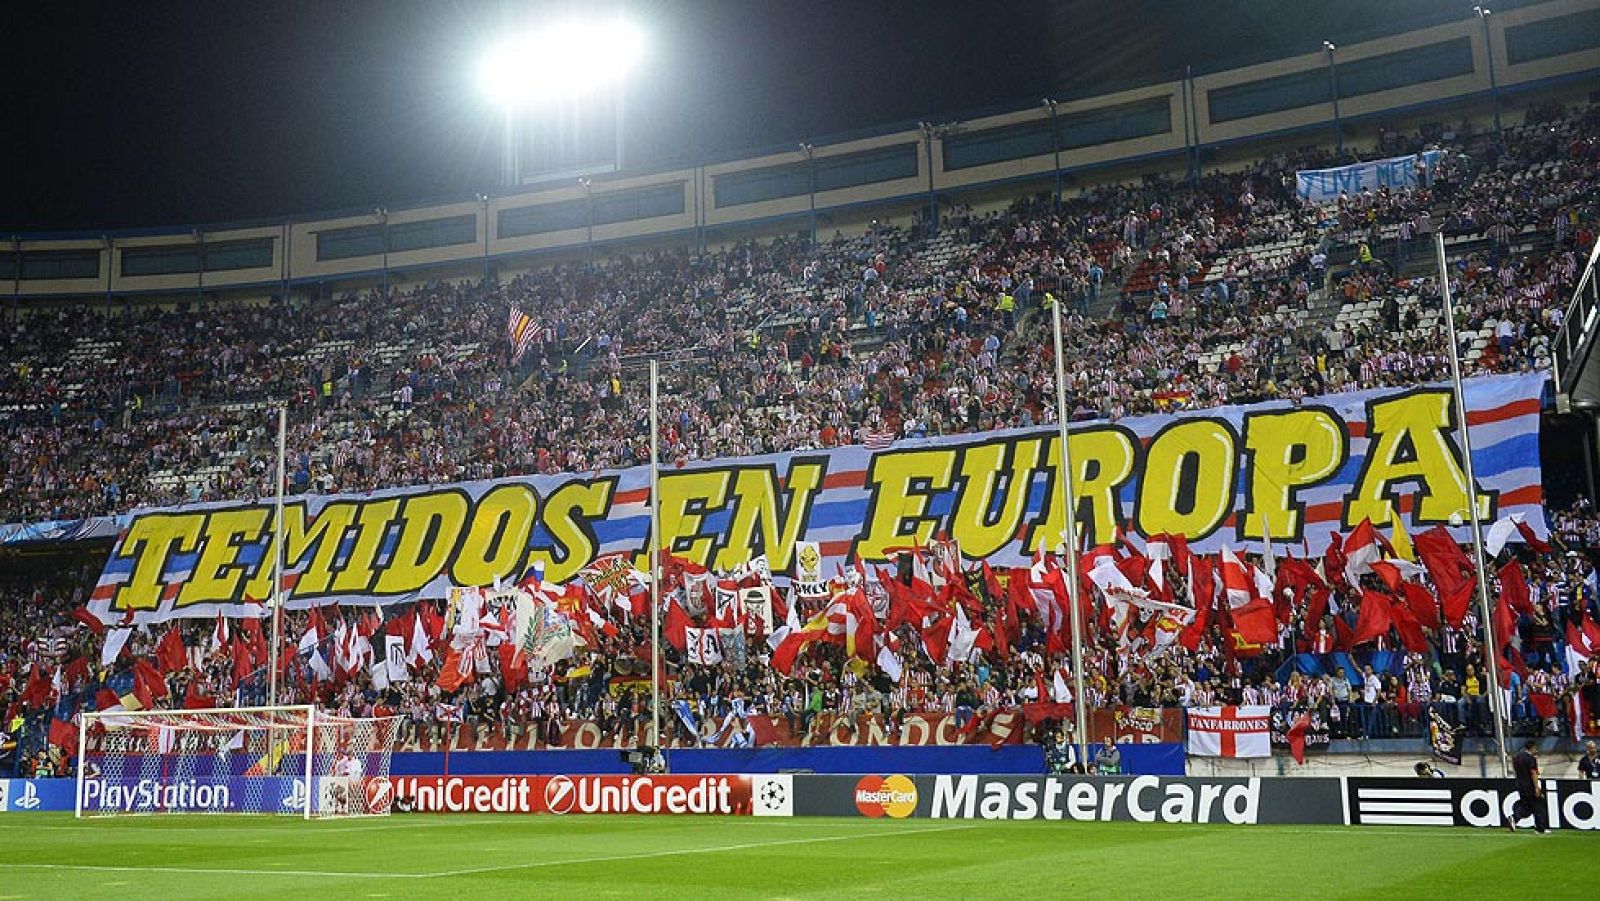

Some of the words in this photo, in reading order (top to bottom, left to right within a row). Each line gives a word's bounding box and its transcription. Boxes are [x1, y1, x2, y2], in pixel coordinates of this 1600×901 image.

[110, 475, 619, 611] TEMIDOS
[635, 458, 829, 576] EN
[846, 387, 1498, 566] EUROPA
[1190, 717, 1268, 731] FANFARRONES
[83, 777, 230, 812] PlayStation
[397, 777, 531, 813] UniCredit
[579, 777, 732, 814] UniCredit
[856, 789, 914, 803] MasterCard
[931, 775, 1260, 824] MasterCard
